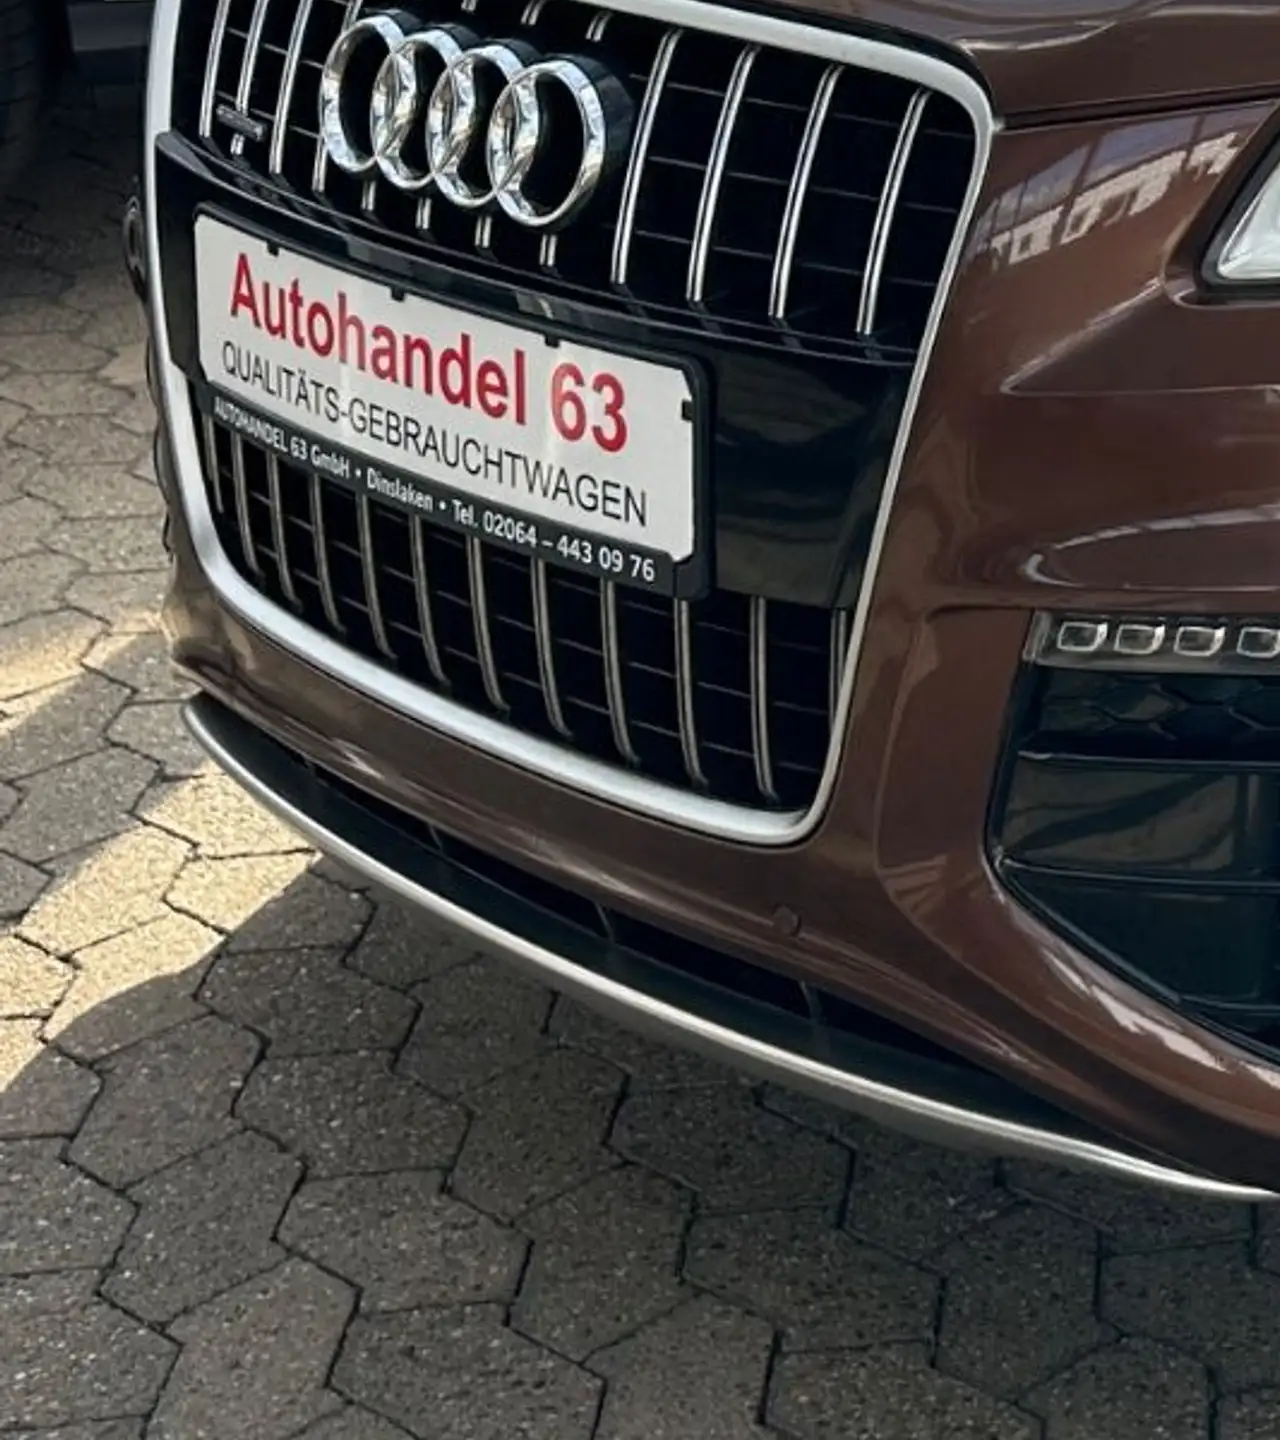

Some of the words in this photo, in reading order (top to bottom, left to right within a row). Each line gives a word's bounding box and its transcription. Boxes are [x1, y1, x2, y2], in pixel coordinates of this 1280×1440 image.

[222, 340, 647, 527] QUALITÄTS-GEBRAUCHTWAGEN
[230, 252, 525, 426] Autohandel
[551, 362, 628, 453] 63
[290, 436, 308, 460] 63
[311, 446, 350, 479] GmbH
[366, 467, 433, 513] Dinslaken
[451, 499, 479, 528] Tel.
[482, 510, 538, 549] 02064
[556, 534, 592, 564] 443
[599, 546, 623, 573] 09
[628, 553, 655, 582] 76
